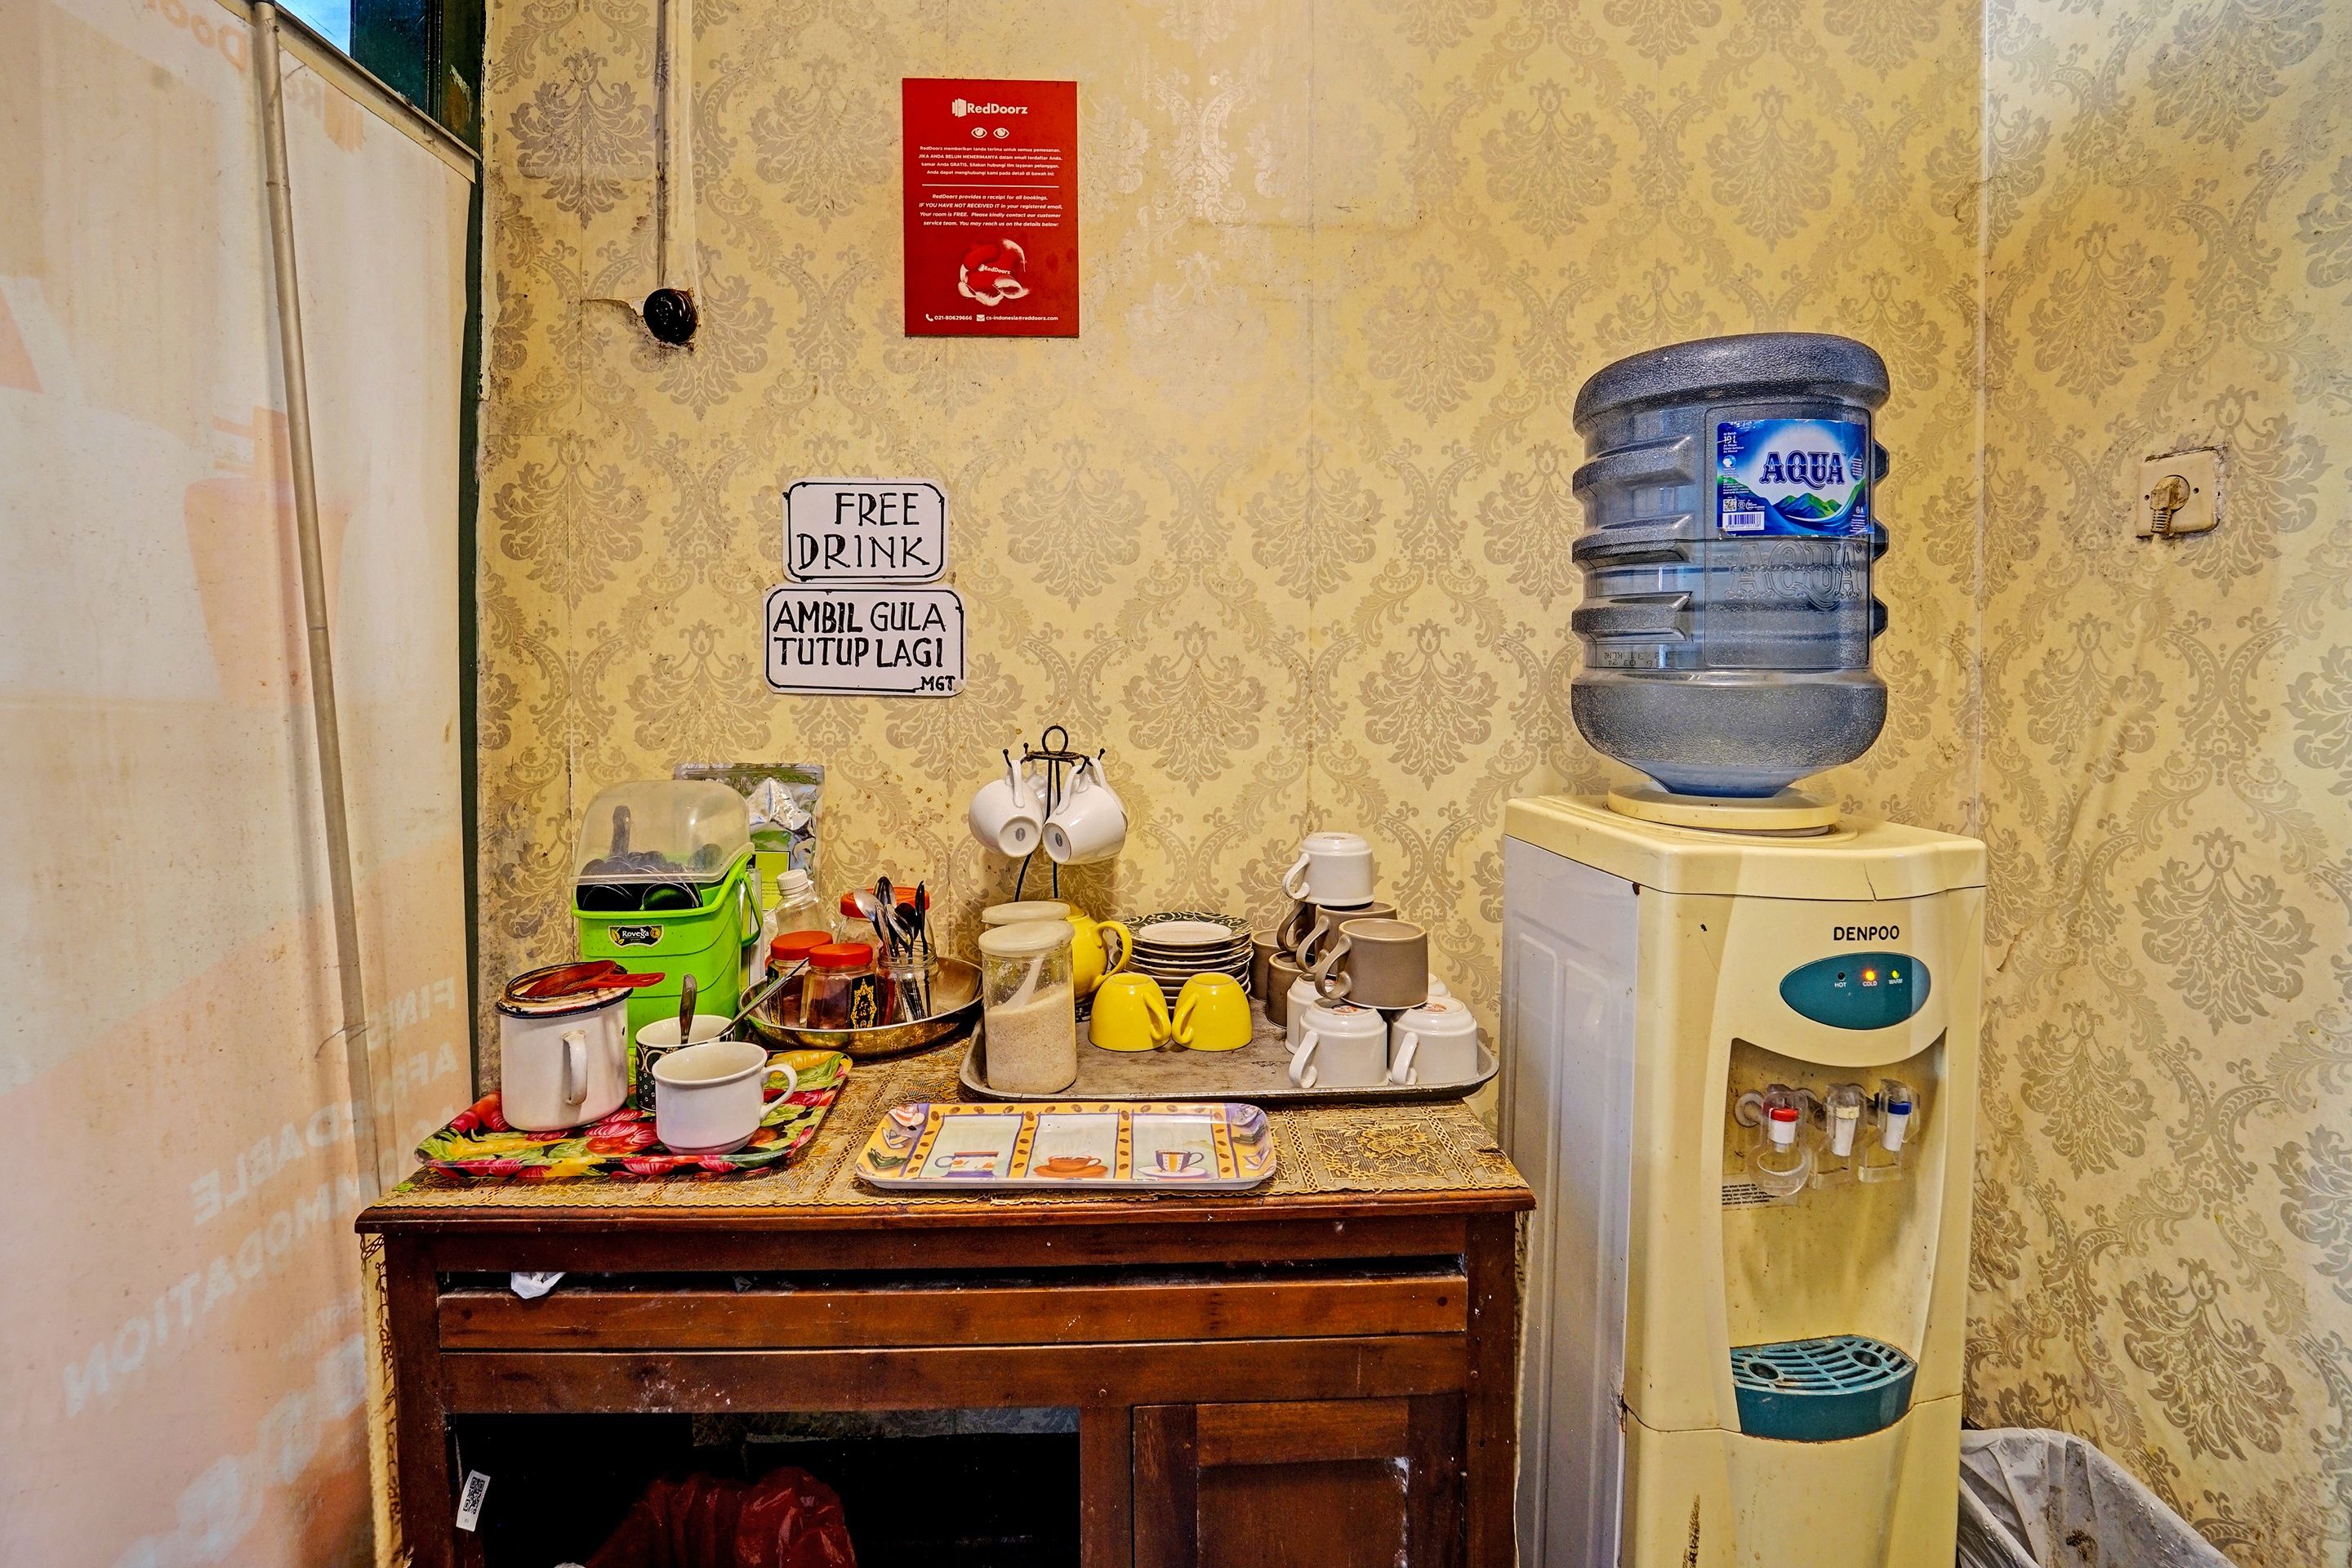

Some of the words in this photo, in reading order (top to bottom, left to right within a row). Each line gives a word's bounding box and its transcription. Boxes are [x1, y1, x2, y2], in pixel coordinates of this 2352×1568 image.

[967, 103, 1028, 114] RedDoorz
[984, 265, 1011, 275] RedDoorz
[1759, 450, 1845, 490] AQUA
[835, 492, 920, 526] FREE
[796, 533, 929, 569] DRINK
[773, 601, 863, 633] AMBIL
[870, 601, 947, 632] GULA
[773, 637, 869, 666] TUTUP
[875, 637, 943, 667] LAGI
[920, 675, 956, 692] MGT
[622, 929, 649, 938] Rovega
[1833, 925, 1900, 941] DENPOO
